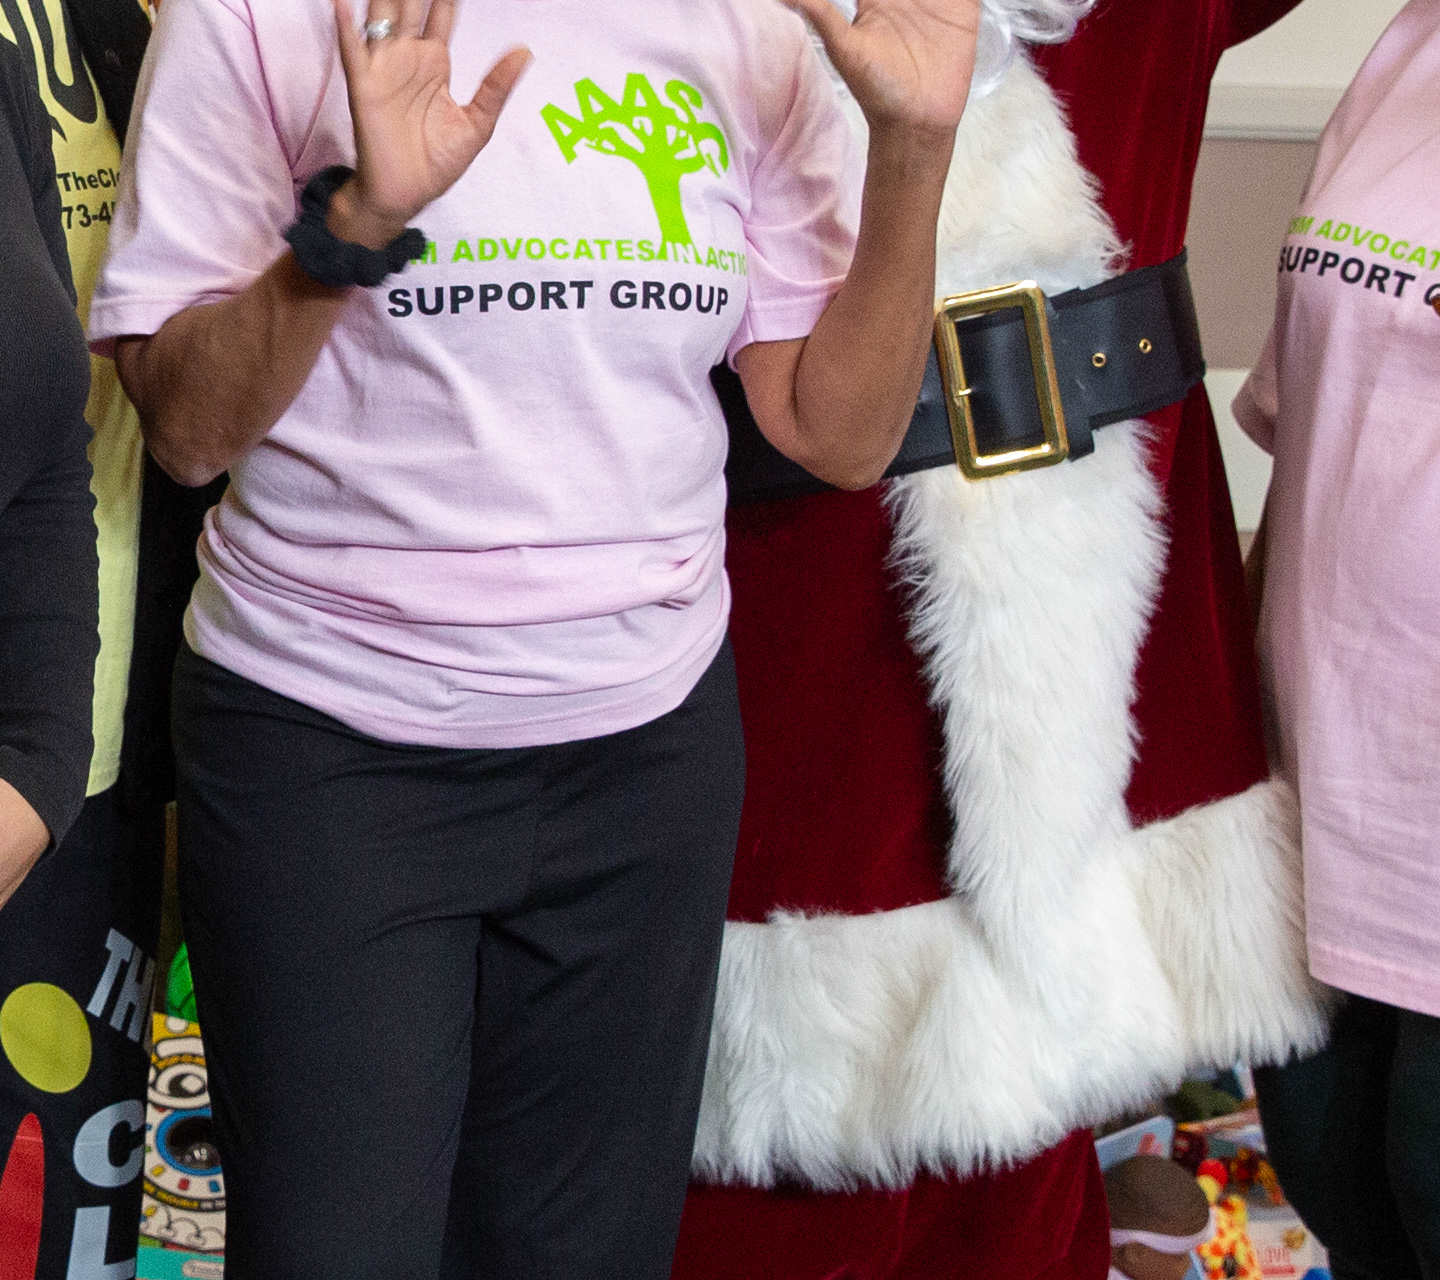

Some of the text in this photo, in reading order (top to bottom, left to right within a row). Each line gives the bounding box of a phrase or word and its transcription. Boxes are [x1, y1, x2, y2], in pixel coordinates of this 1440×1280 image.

[57, 168, 121, 192] TheCl
[61, 201, 116, 230] 73-4
[451, 237, 656, 265] ADVOCATES
[387, 280, 729, 318] SUPPORT GROUP
[86, 928, 157, 1052] TH
